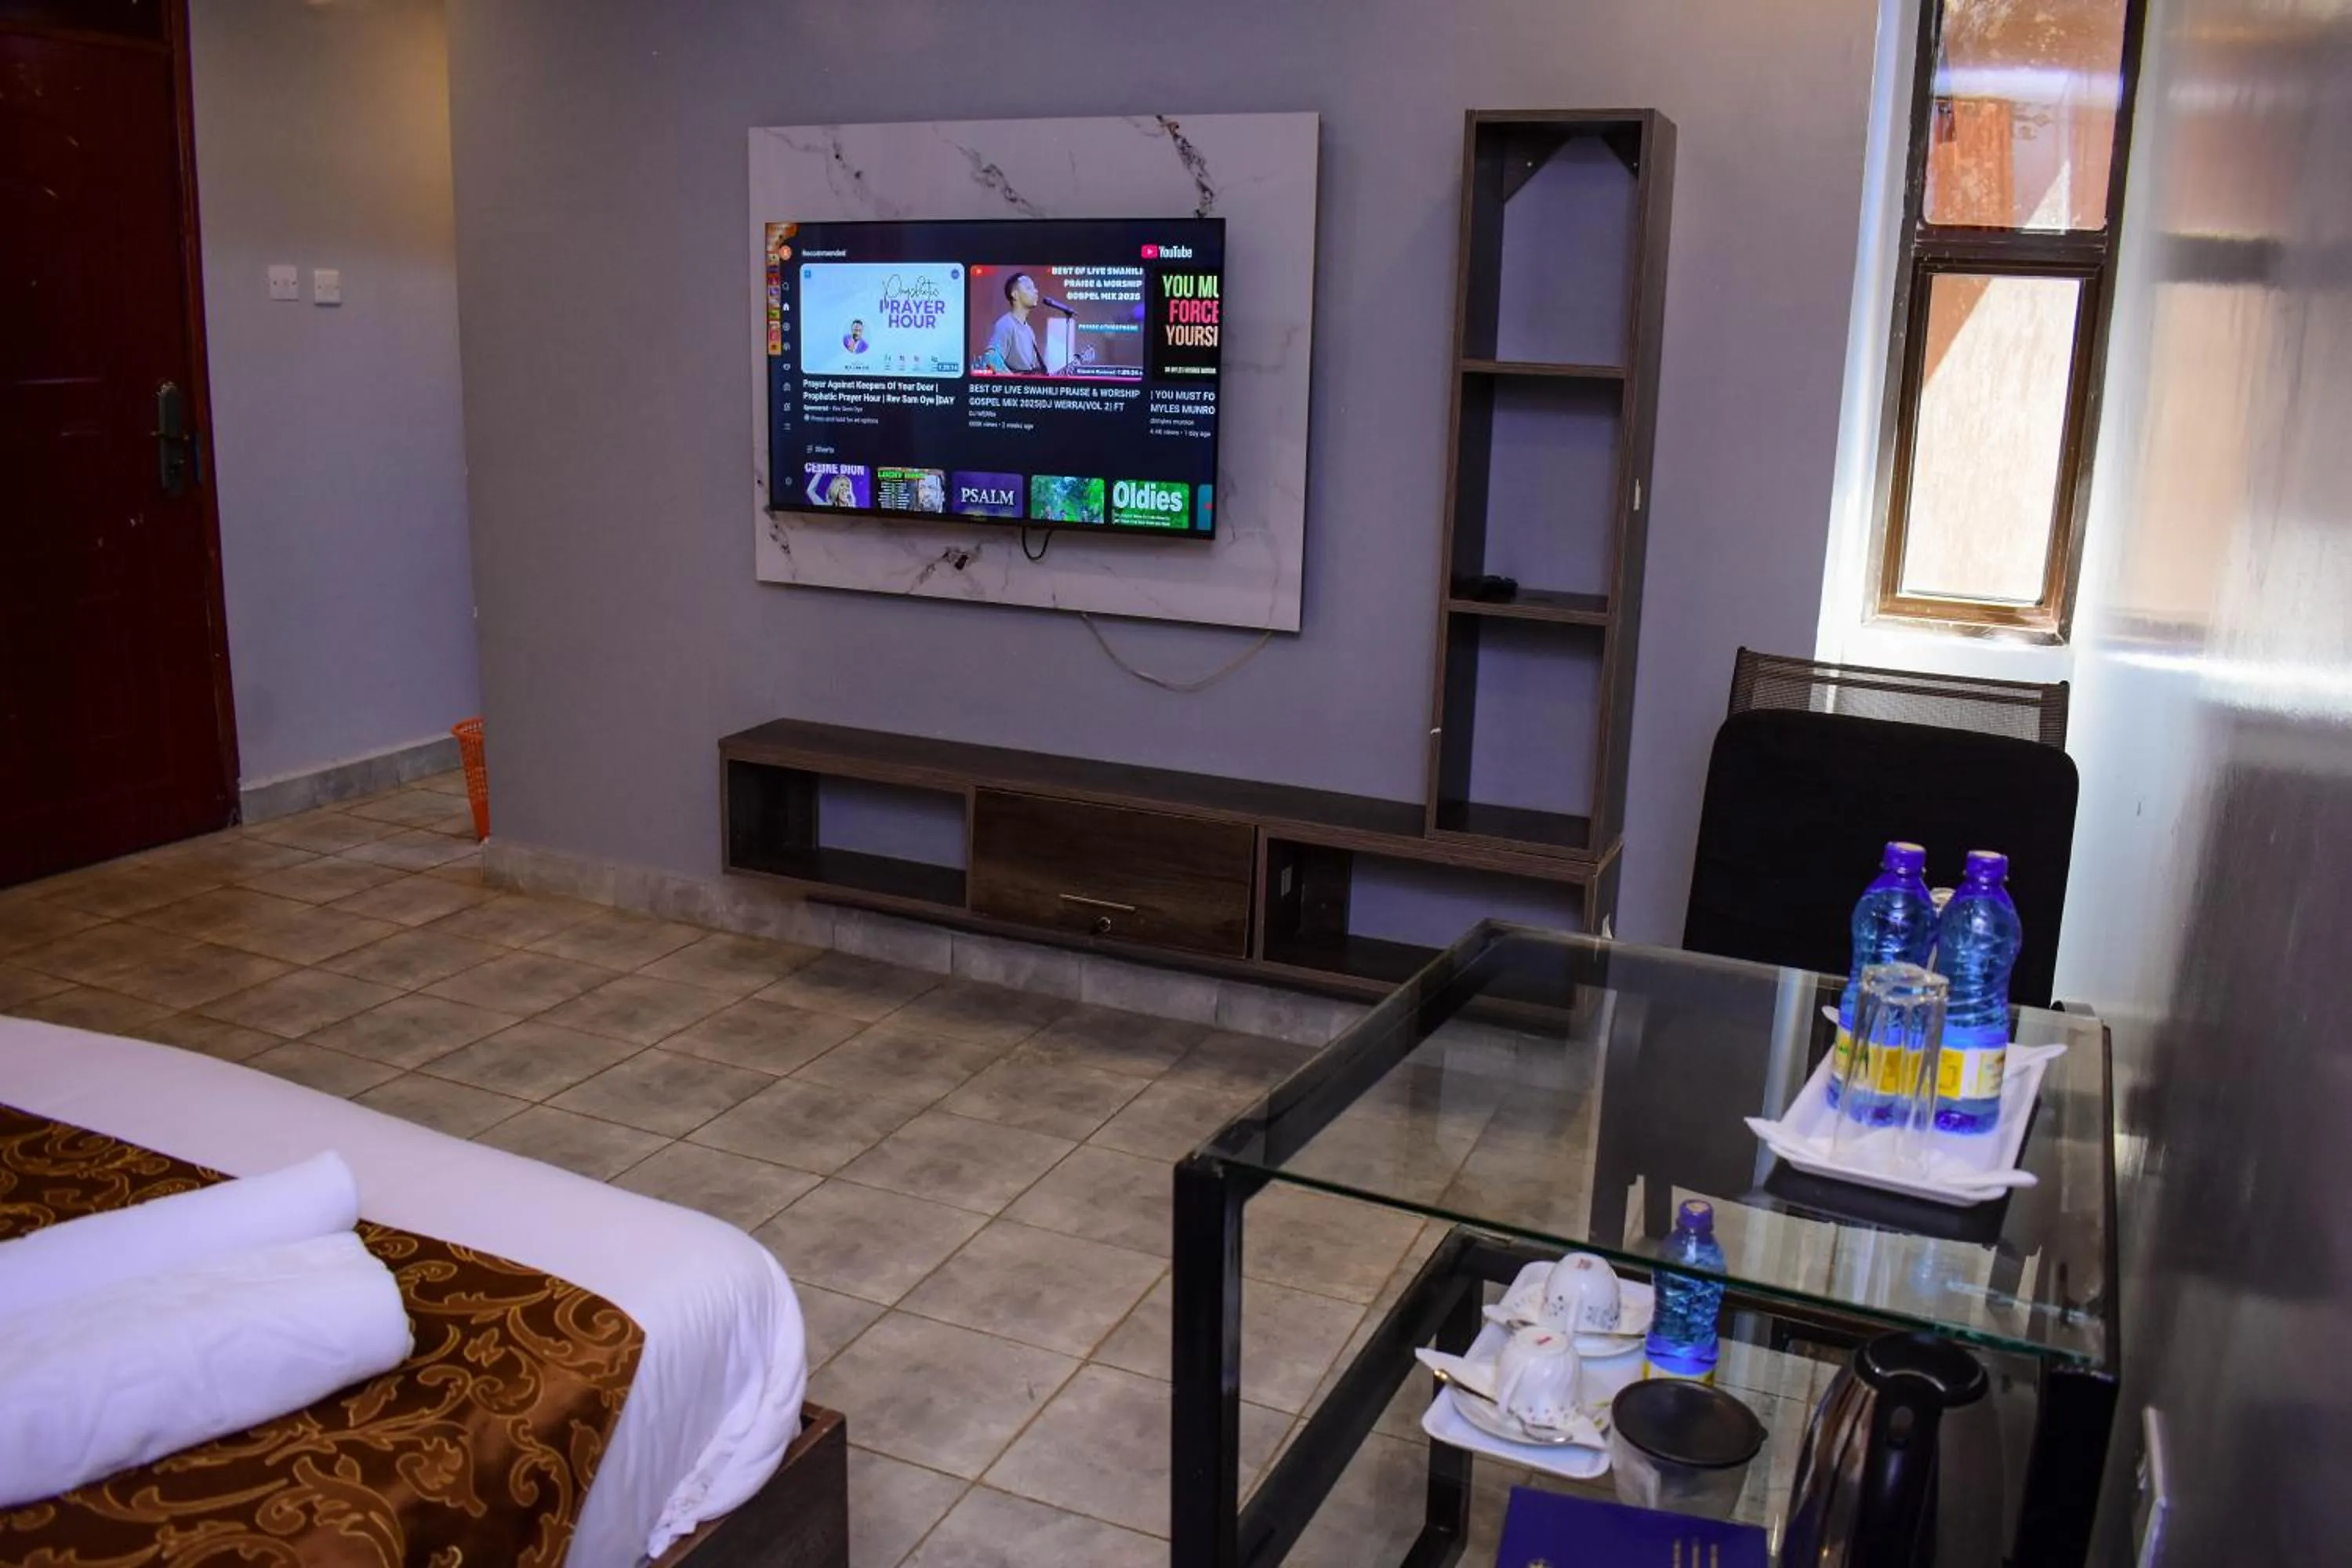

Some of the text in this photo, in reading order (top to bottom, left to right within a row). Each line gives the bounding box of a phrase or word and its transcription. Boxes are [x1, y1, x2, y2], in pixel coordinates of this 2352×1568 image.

[1159, 245, 1192, 259] YouTube
[1052, 267, 1073, 275] BEST
[1162, 274, 1194, 297] YOU
[880, 300, 946, 314] PRAYER
[1169, 299, 1219, 323] FORCE
[888, 314, 936, 328] HOUR
[803, 379, 826, 390] Prayer
[828, 379, 855, 390] Against
[856, 381, 886, 391] Keepers
[887, 381, 896, 390] Of
[916, 382, 935, 391] Door
[969, 383, 1141, 398] BEST OF LIVE SWAHILI PRAISE & WORSHIP
[803, 391, 837, 402] Prophetic
[838, 392, 862, 403] Prayer
[863, 393, 881, 402] Hour
[886, 394, 901, 404] Rev
[902, 394, 919, 404] Sam
[1155, 390, 1174, 400] YOU
[1175, 390, 1201, 401] MUST
[1203, 391, 1216, 401] FO
[969, 397, 1001, 407] GOSPEL
[1003, 397, 1018, 408] MIX
[1113, 401, 1125, 412] FT
[1150, 403, 1216, 415] MYLES MUNRO
[840, 463, 865, 476] DION
[960, 487, 1014, 506] PSALM
[1112, 481, 1183, 512] Oldies
